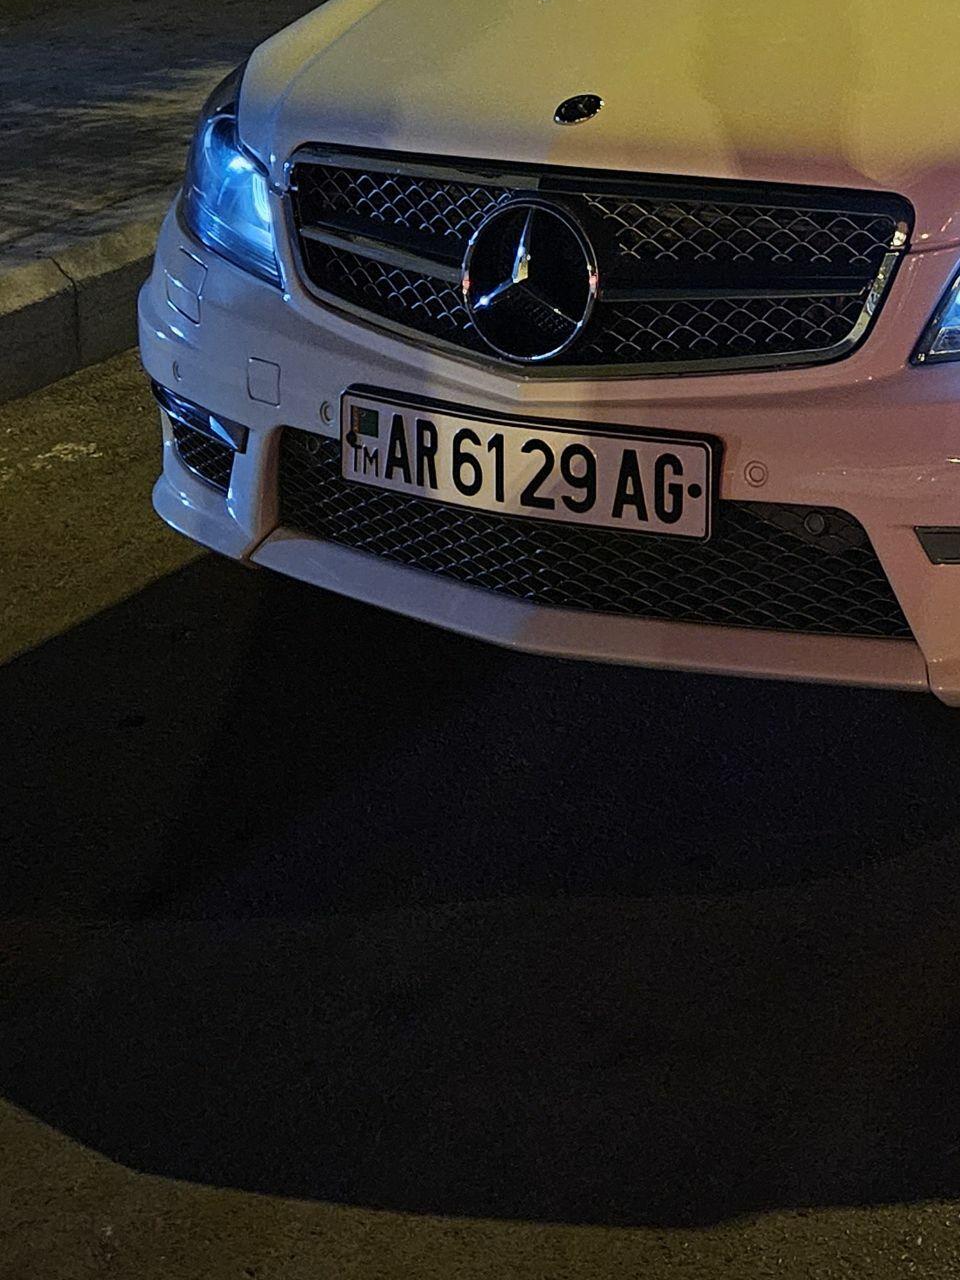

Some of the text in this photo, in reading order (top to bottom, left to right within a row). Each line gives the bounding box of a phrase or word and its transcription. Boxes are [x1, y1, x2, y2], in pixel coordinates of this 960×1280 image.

[353, 443, 379, 478] TM
[384, 413, 684, 524] AR 6129 AG
